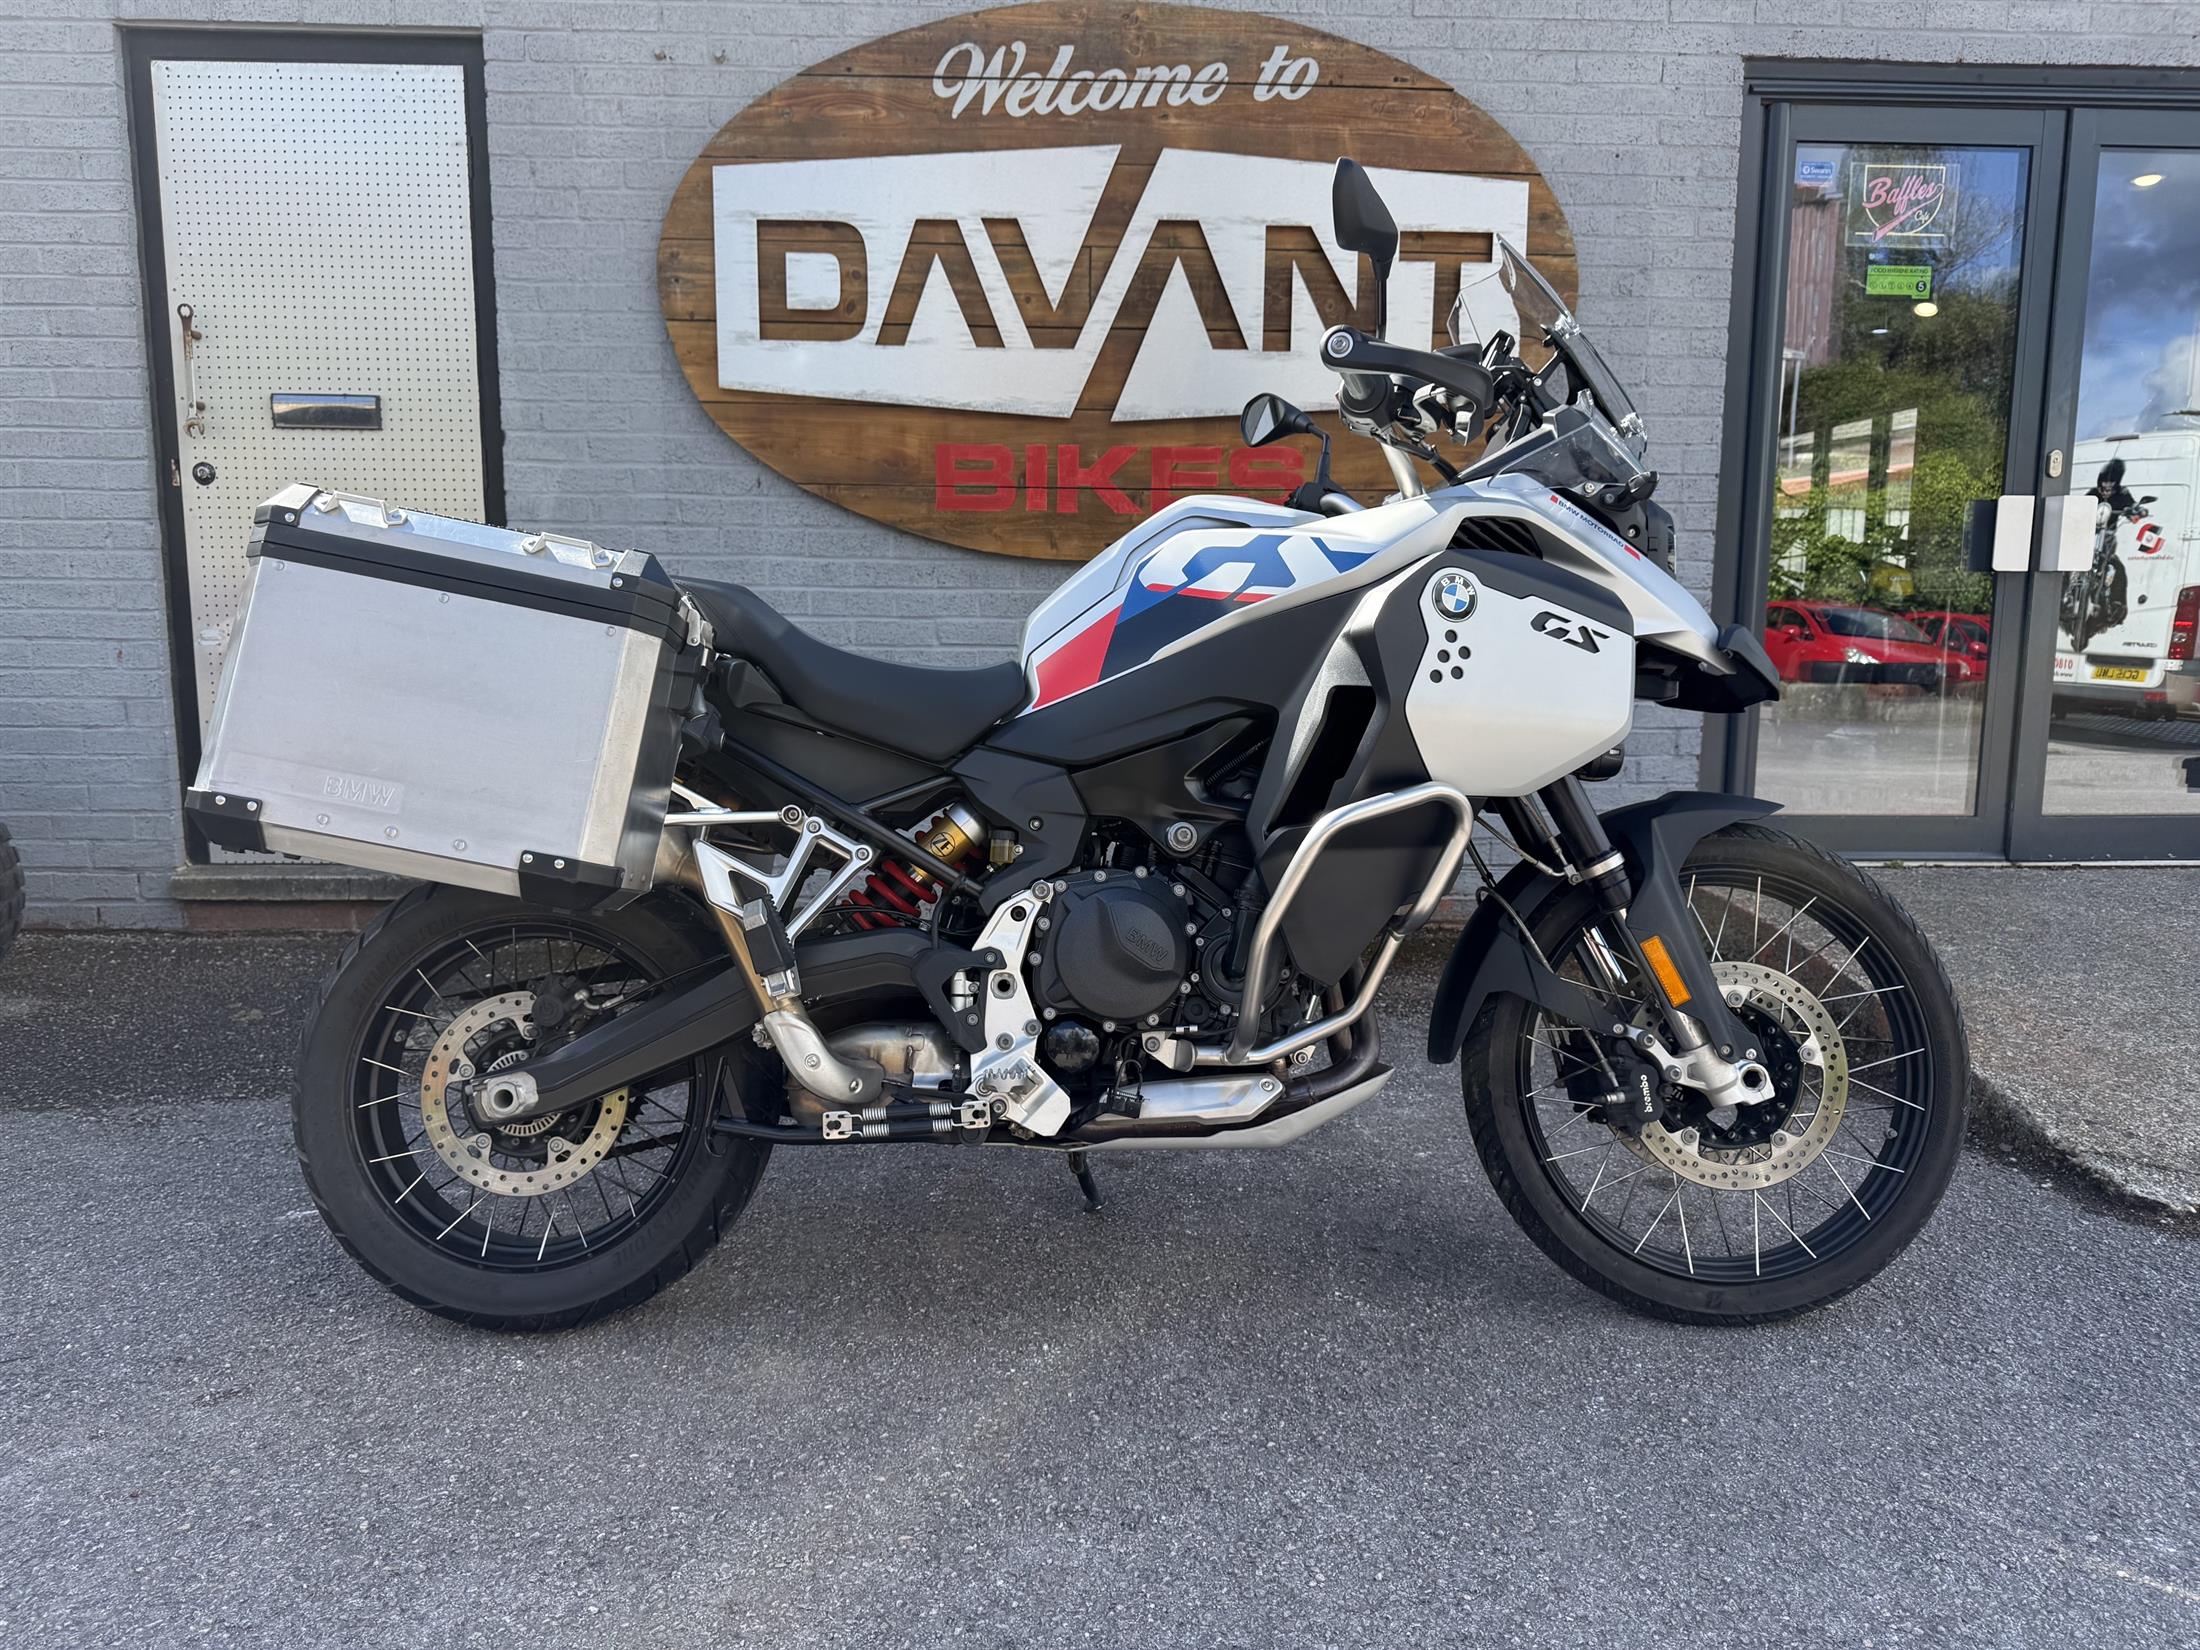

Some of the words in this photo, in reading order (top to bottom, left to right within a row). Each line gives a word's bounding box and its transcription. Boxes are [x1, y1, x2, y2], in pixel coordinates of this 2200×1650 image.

[933, 40, 1229, 119] Welcome
[1253, 45, 1319, 102] to
[1862, 175, 1944, 215] Baffles
[757, 218, 1493, 353] DAVANT
[935, 444, 1306, 514] BIKES
[1558, 500, 1580, 517] BMW
[1580, 514, 1624, 548] MOTORRAD
[1441, 575, 1476, 596] BMW
[1530, 611, 1610, 654] GS
[321, 775, 396, 807] BMW
[931, 832, 955, 857] ZF
[1126, 927, 1168, 961] BMW
[1640, 1074, 1653, 1113] brembo
